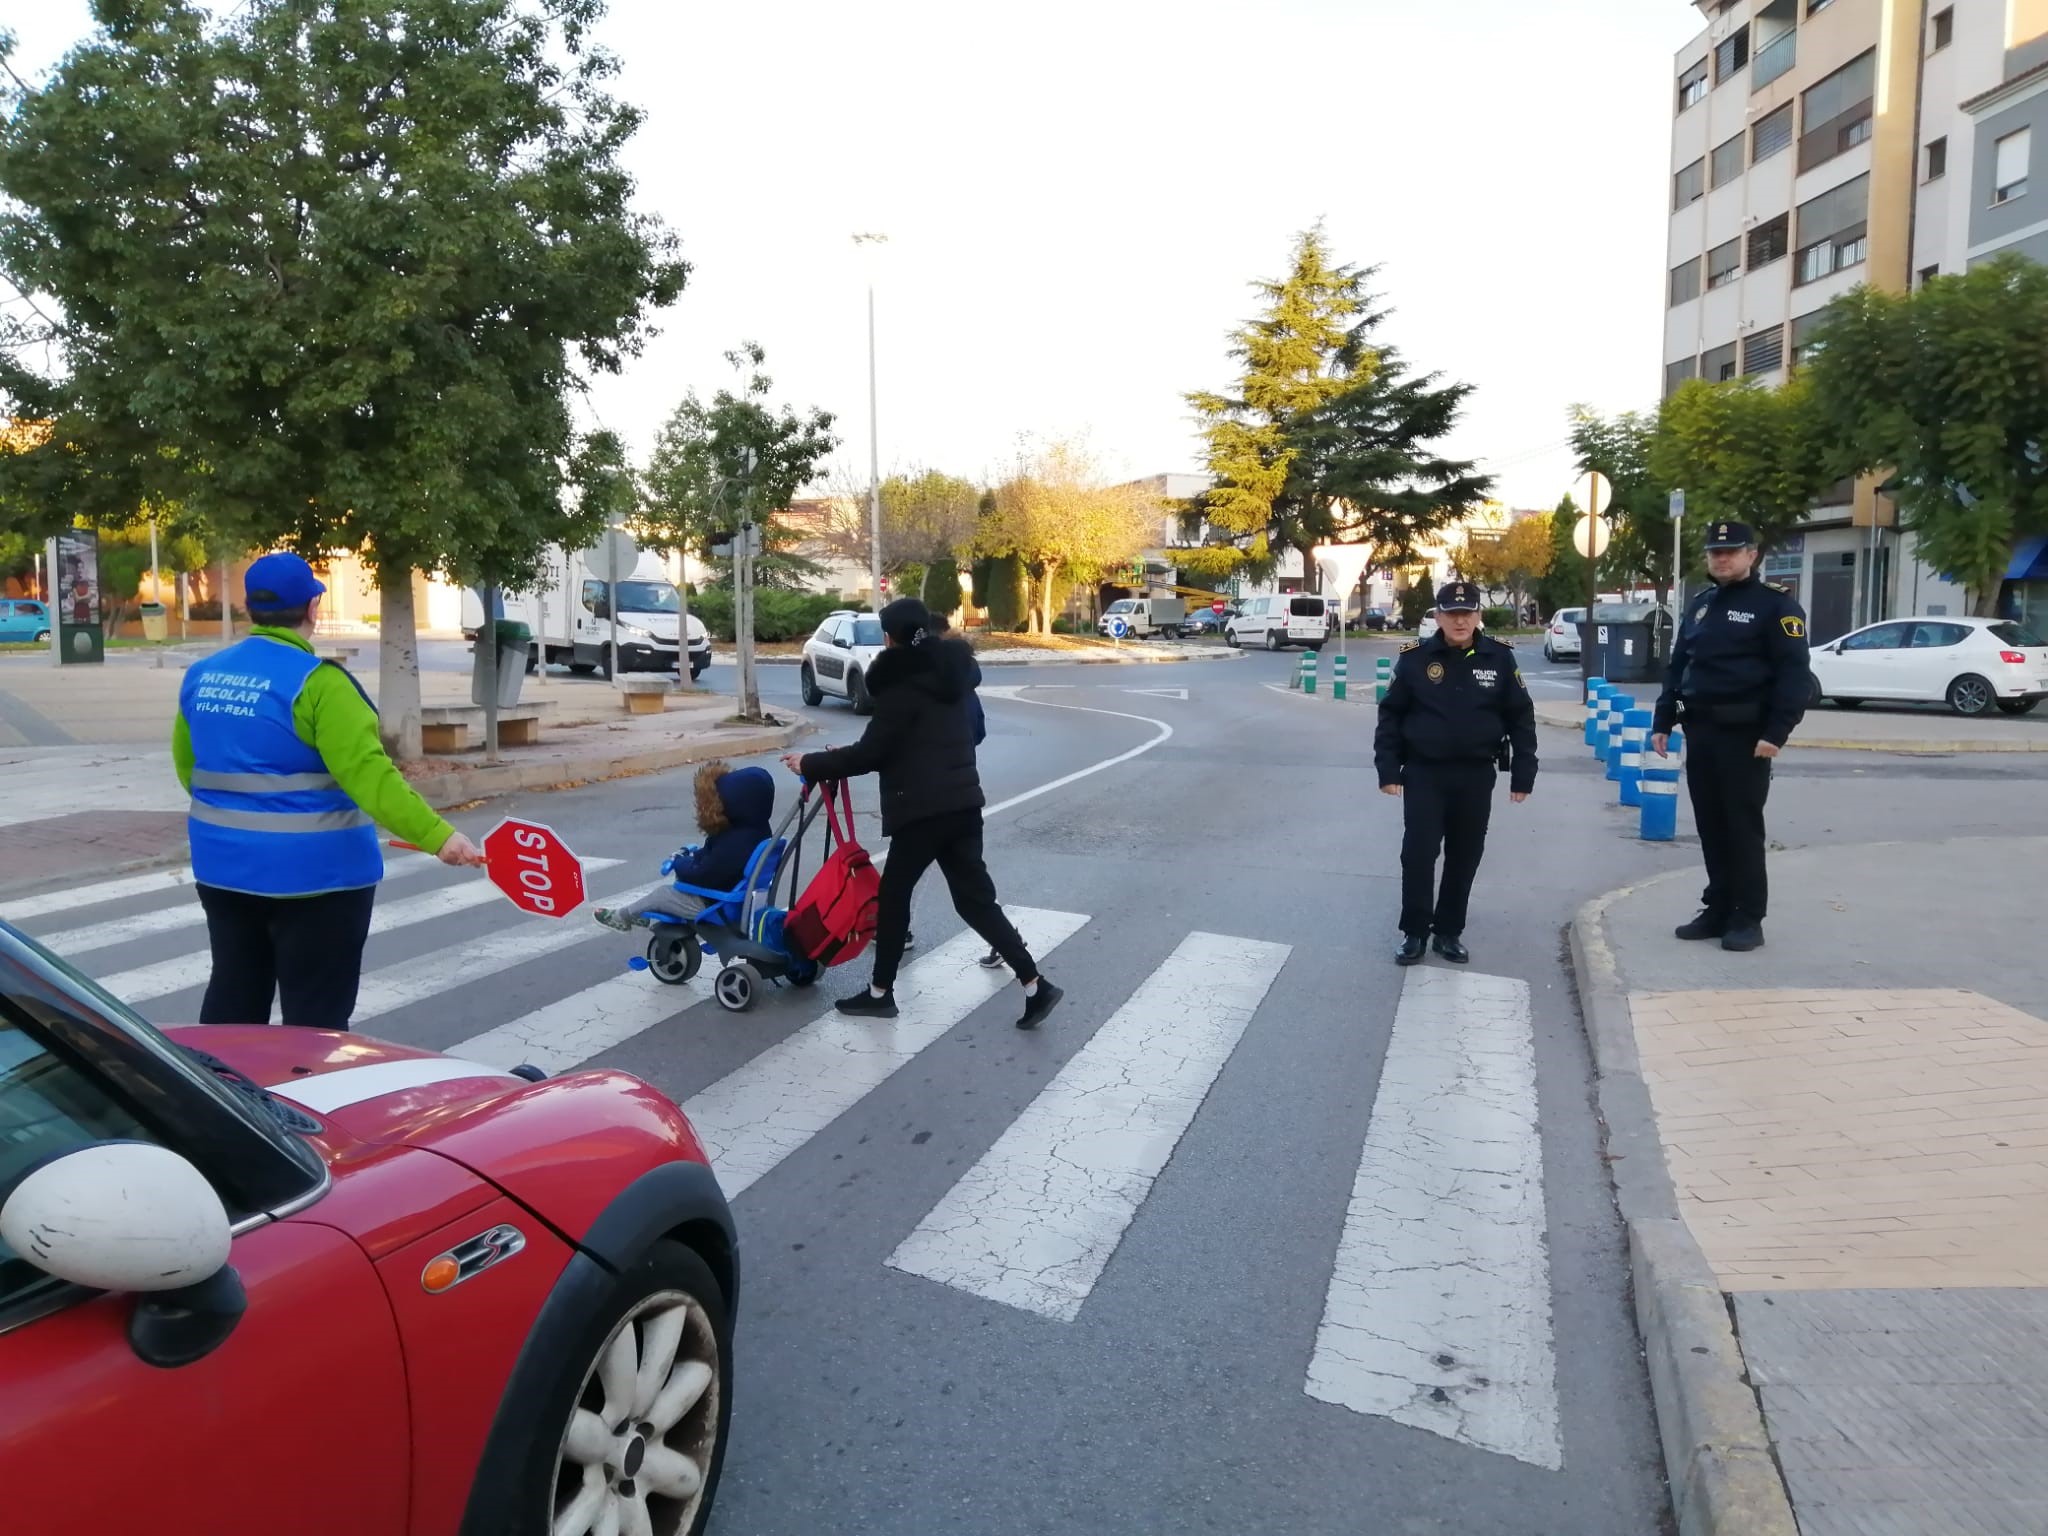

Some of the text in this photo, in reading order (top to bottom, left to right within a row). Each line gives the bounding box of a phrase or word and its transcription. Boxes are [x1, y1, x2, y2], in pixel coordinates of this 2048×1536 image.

[200, 672, 271, 690] PATRULLA
[198, 687, 260, 704] ESCOLAR
[514, 829, 555, 911] STOP
